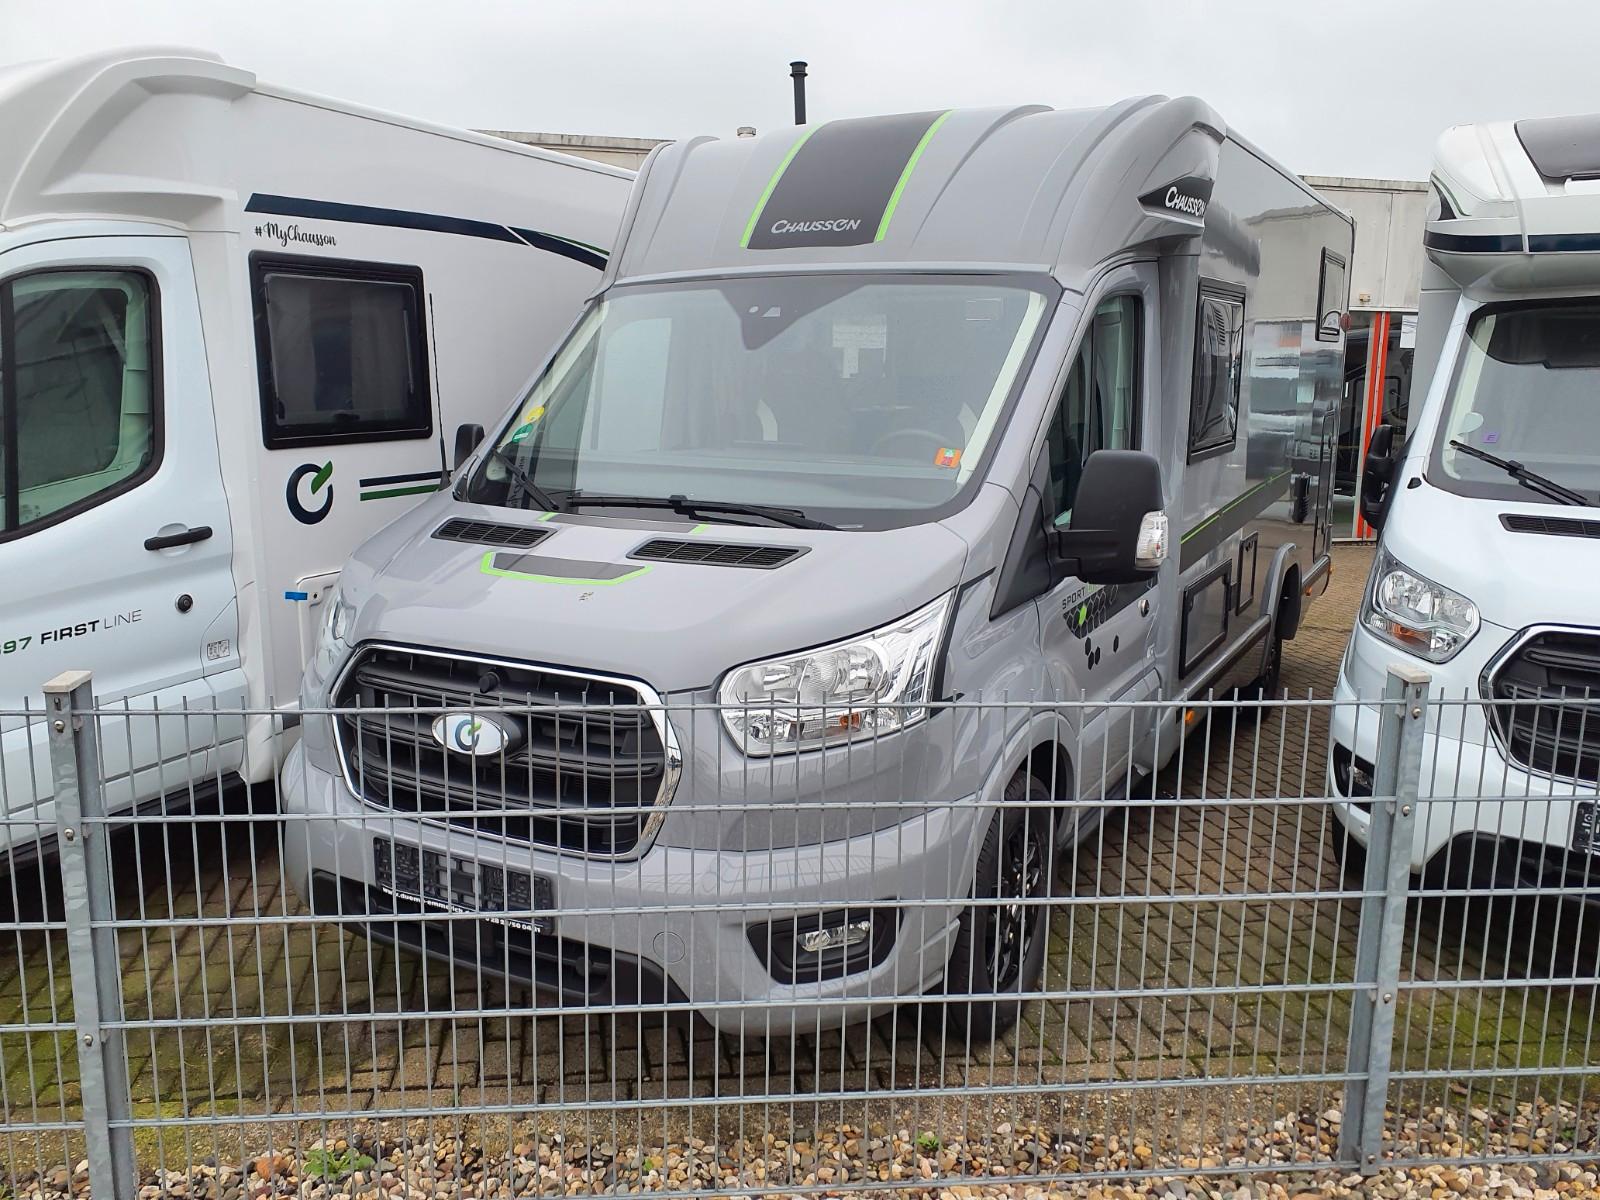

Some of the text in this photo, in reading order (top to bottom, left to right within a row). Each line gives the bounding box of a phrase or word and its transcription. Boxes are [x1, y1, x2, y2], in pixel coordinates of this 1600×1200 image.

[1165, 186, 1206, 217] CHAUSSON
[255, 221, 336, 247] #MyChausson
[771, 219, 861, 234] CHAUSSON
[1062, 586, 1085, 610] SPORT
[41, 619, 100, 645] FIRST
[104, 609, 142, 629] LINE
